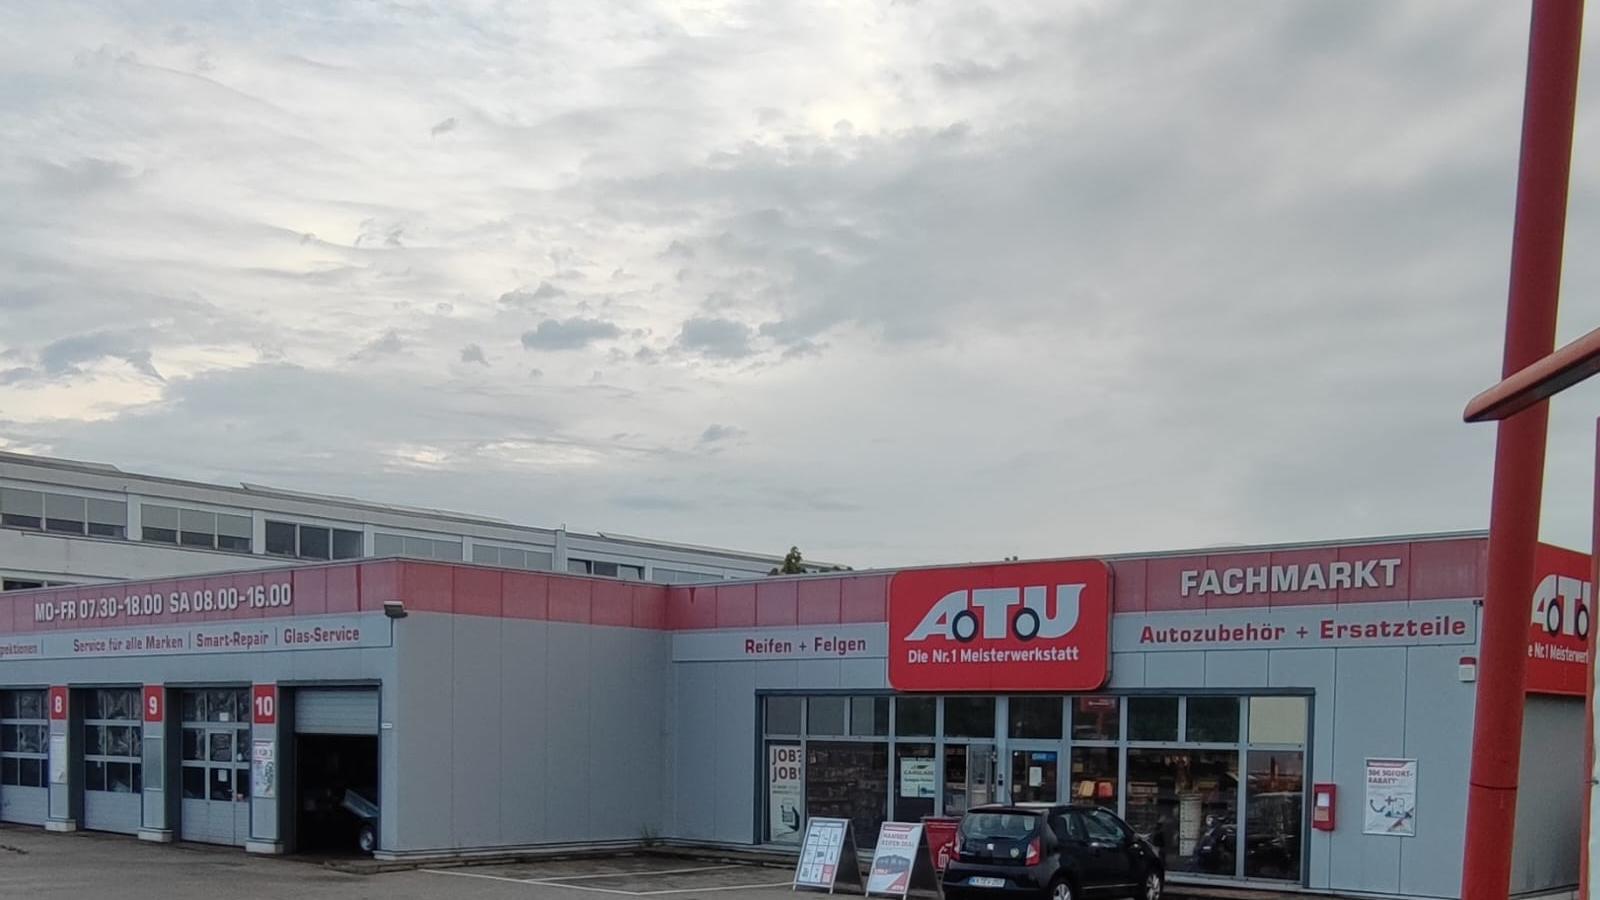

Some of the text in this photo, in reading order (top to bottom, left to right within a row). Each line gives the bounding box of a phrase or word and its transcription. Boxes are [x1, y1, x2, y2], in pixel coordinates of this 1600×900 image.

[1180, 557, 1402, 597] FACHMARKT
[34, 583, 292, 622] MO-FR 07.30-18.00 SA 08.00-16.00
[904, 583, 1087, 643] ATU
[284, 625, 361, 644] Glas-Service
[1140, 616, 1467, 645] Autozubehör + Ersatzteile
[73, 634, 184, 653] Service für alle Marken
[196, 631, 269, 650] Smart-Repair
[745, 636, 867, 656] Reifen + Felgen
[908, 645, 1080, 664] Die Nr.1 Meisterwerkstatt
[54, 695, 63, 713] 8
[149, 696, 158, 715] 9
[255, 696, 274, 716] 10
